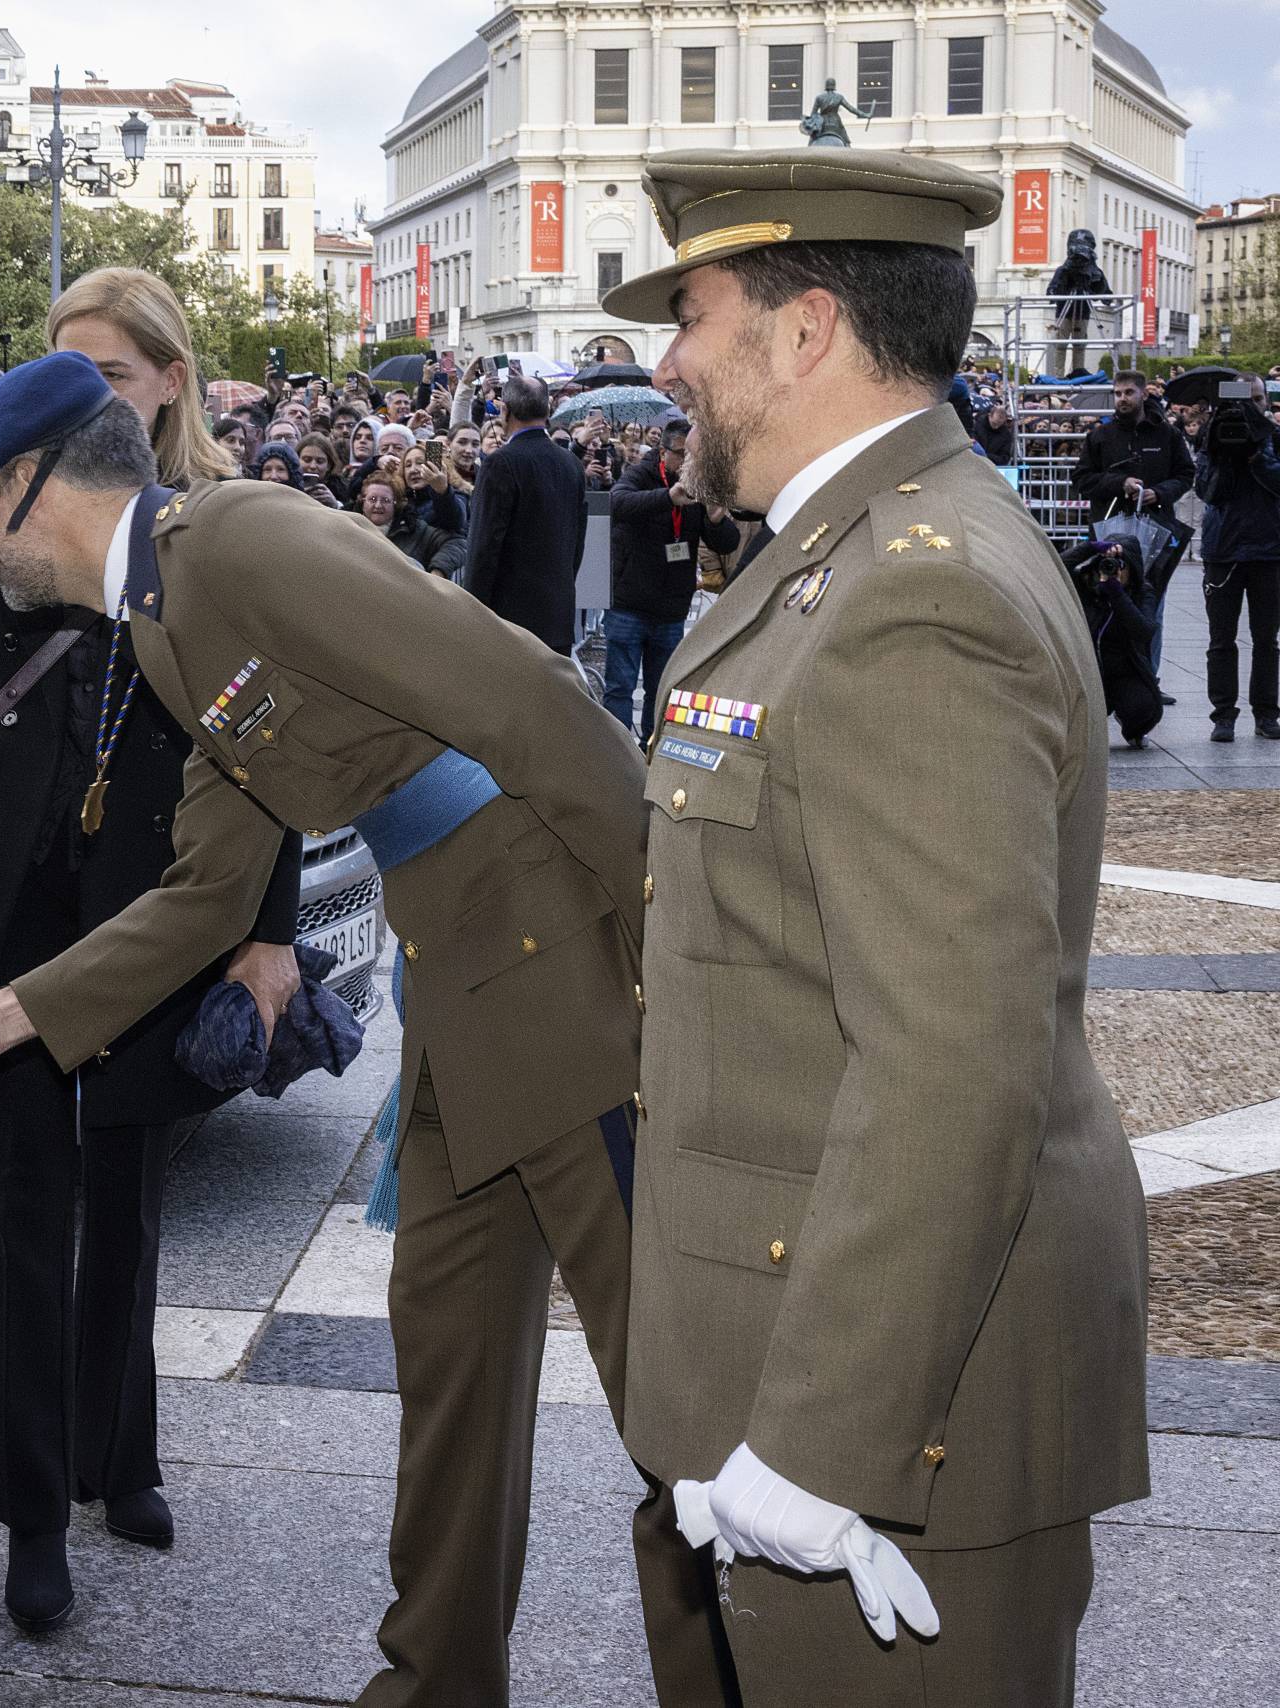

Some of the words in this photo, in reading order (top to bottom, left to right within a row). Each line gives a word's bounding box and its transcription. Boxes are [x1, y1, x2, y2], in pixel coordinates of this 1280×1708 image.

[662, 741, 673, 751] DE
[670, 743, 682, 755] LAS
[350, 918, 372, 962] LST
